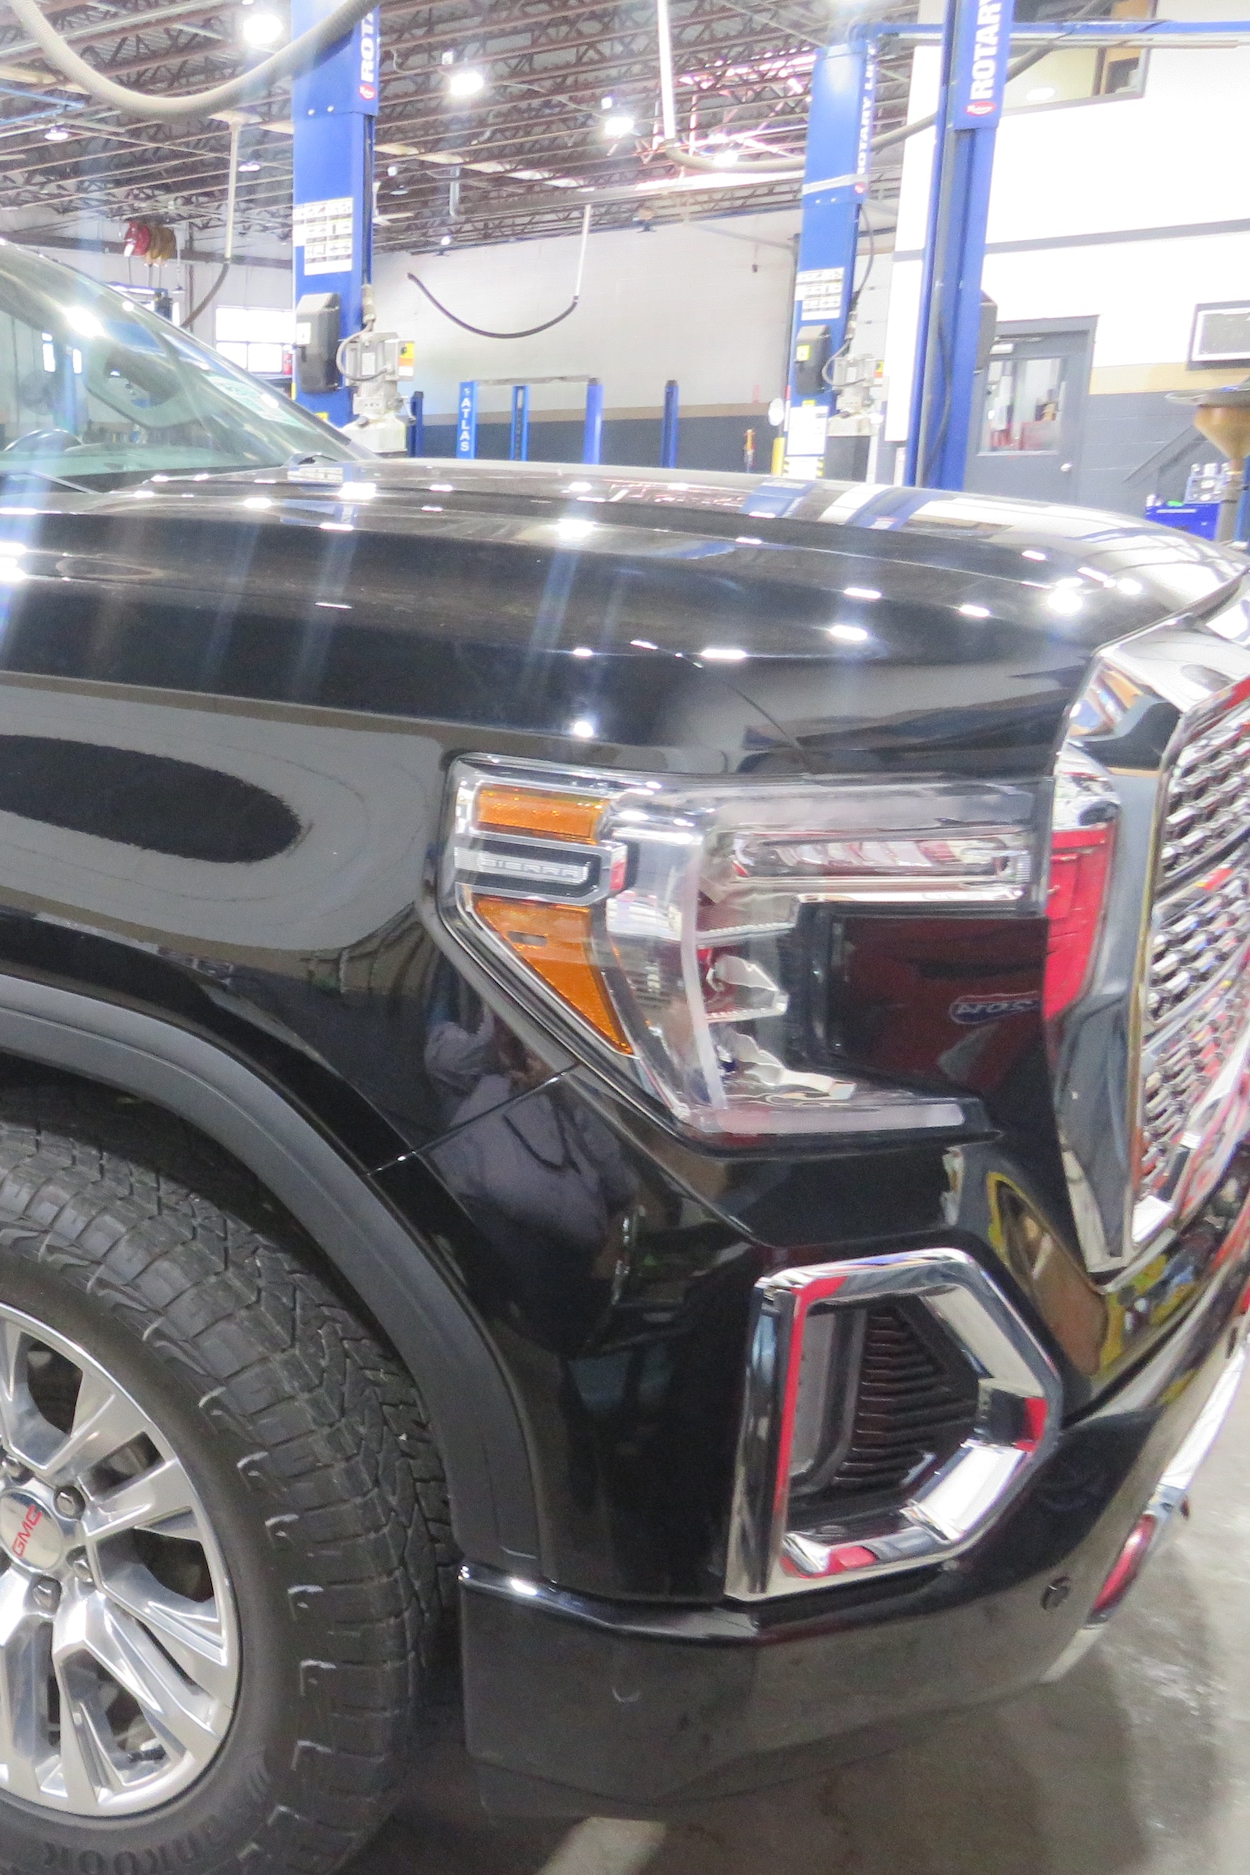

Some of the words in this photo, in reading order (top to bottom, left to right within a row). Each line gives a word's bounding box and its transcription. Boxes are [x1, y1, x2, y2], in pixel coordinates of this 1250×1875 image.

[459, 397, 471, 452] ATLAS
[478, 857, 580, 878] SIERRA
[12, 1504, 43, 1558] GMC
